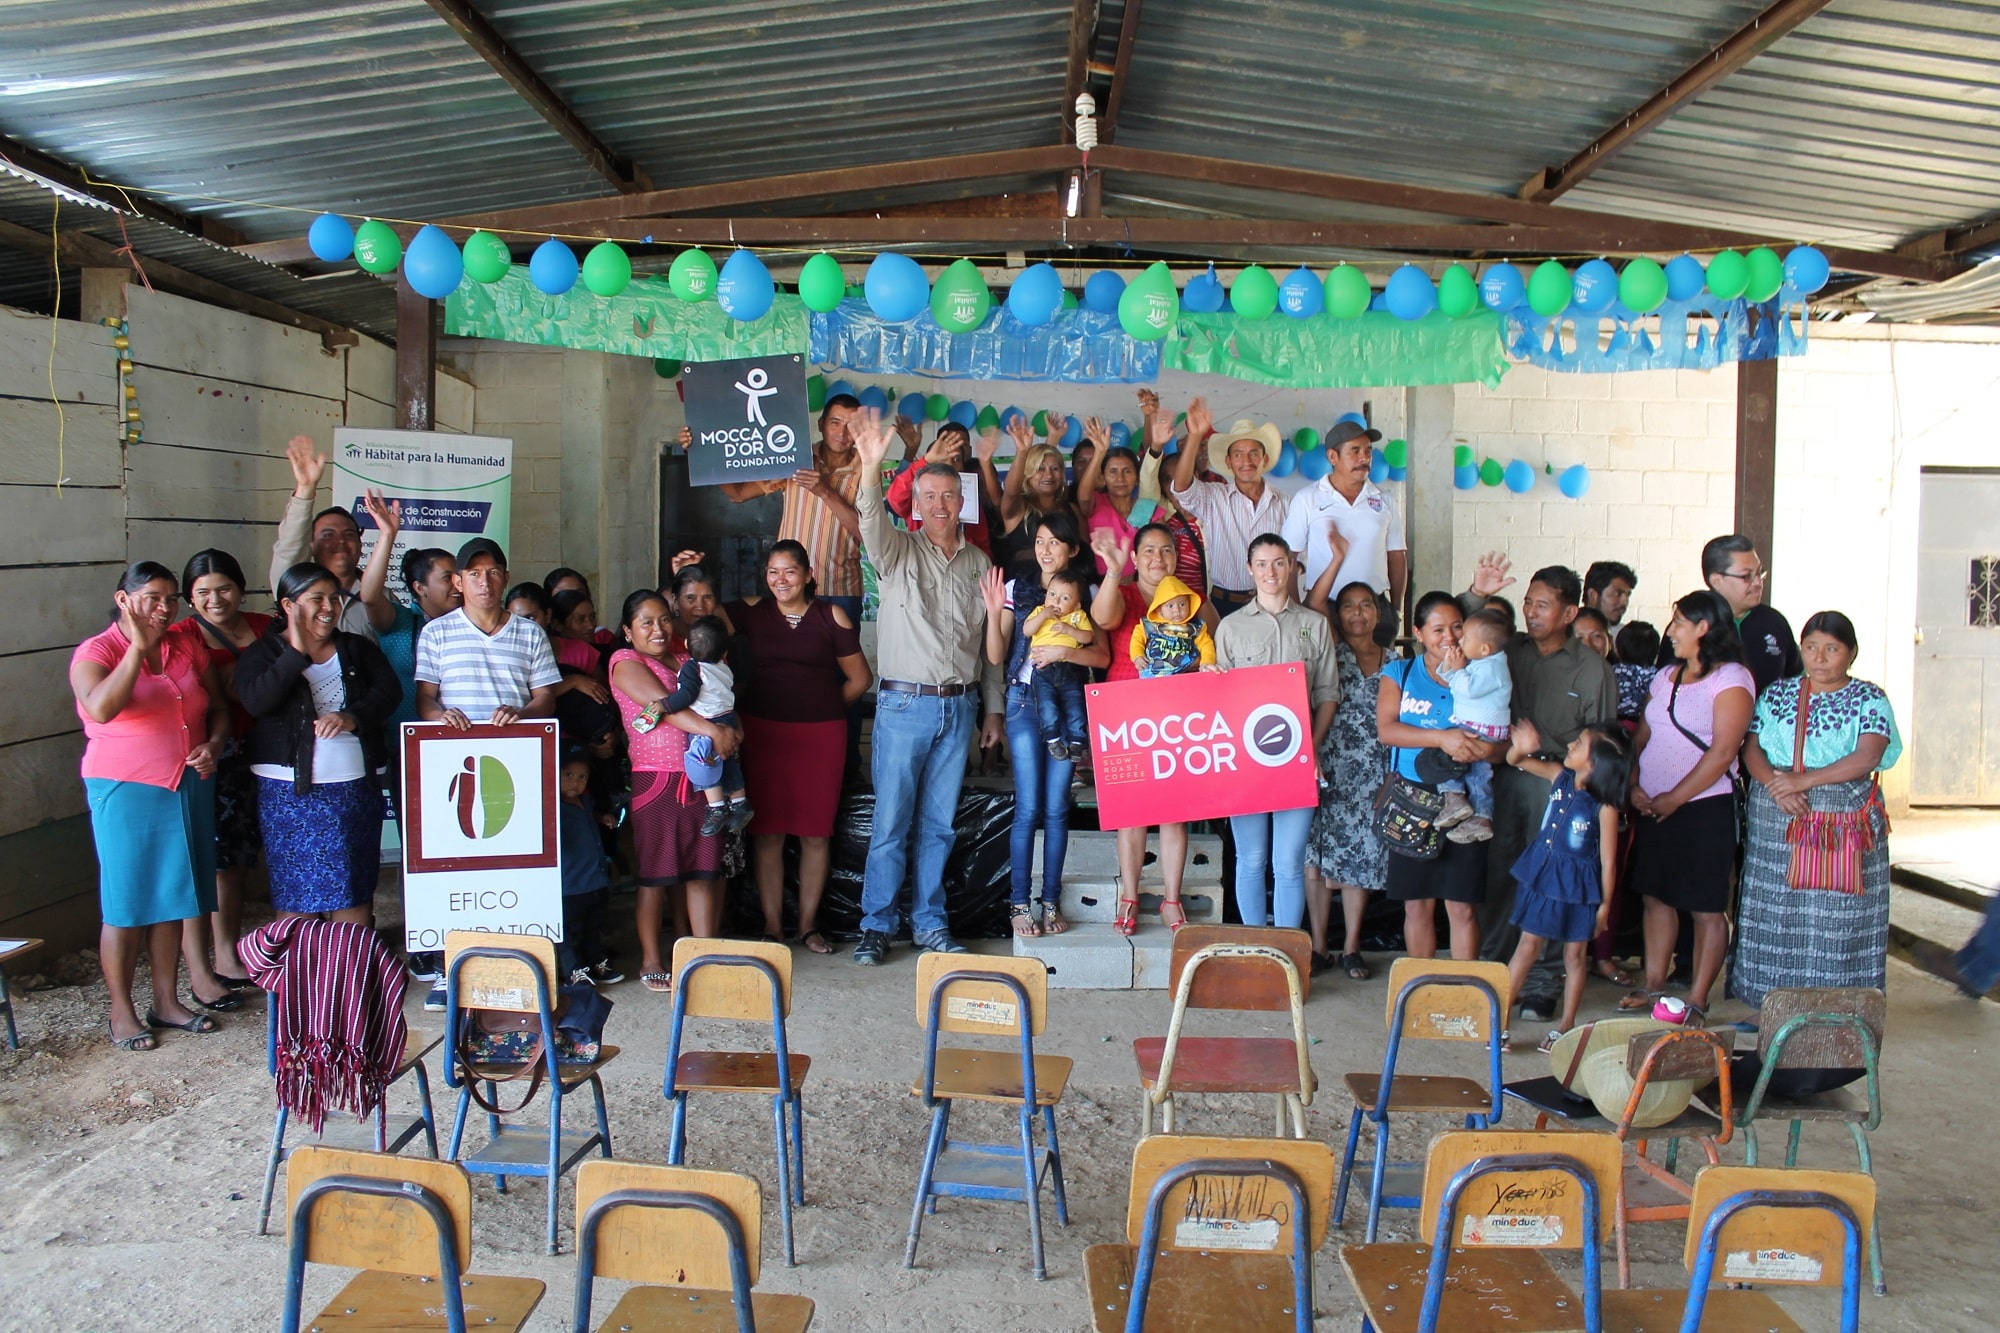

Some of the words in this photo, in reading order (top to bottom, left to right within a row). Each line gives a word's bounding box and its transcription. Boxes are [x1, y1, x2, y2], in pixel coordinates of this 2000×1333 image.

[700, 427, 763, 446] MOCCA
[724, 441, 765, 458] D'OR
[365, 448, 405, 461] Hábitat
[407, 453, 432, 464] para
[434, 452, 444, 463] la
[446, 453, 505, 467] Humanidad
[725, 455, 796, 469] FOUNDATION
[404, 505, 419, 516] de
[420, 506, 482, 519] Construcción
[405, 516, 448, 528] Vivienda
[1098, 709, 1234, 753] MOCCA
[1103, 756, 1132, 767] SLOW
[1151, 742, 1238, 780] D'OR
[1103, 763, 1140, 774] ROAST
[1104, 770, 1146, 782] COFFEE
[449, 890, 519, 911] EFICO
[1491, 1217, 1538, 1227] mineduc
